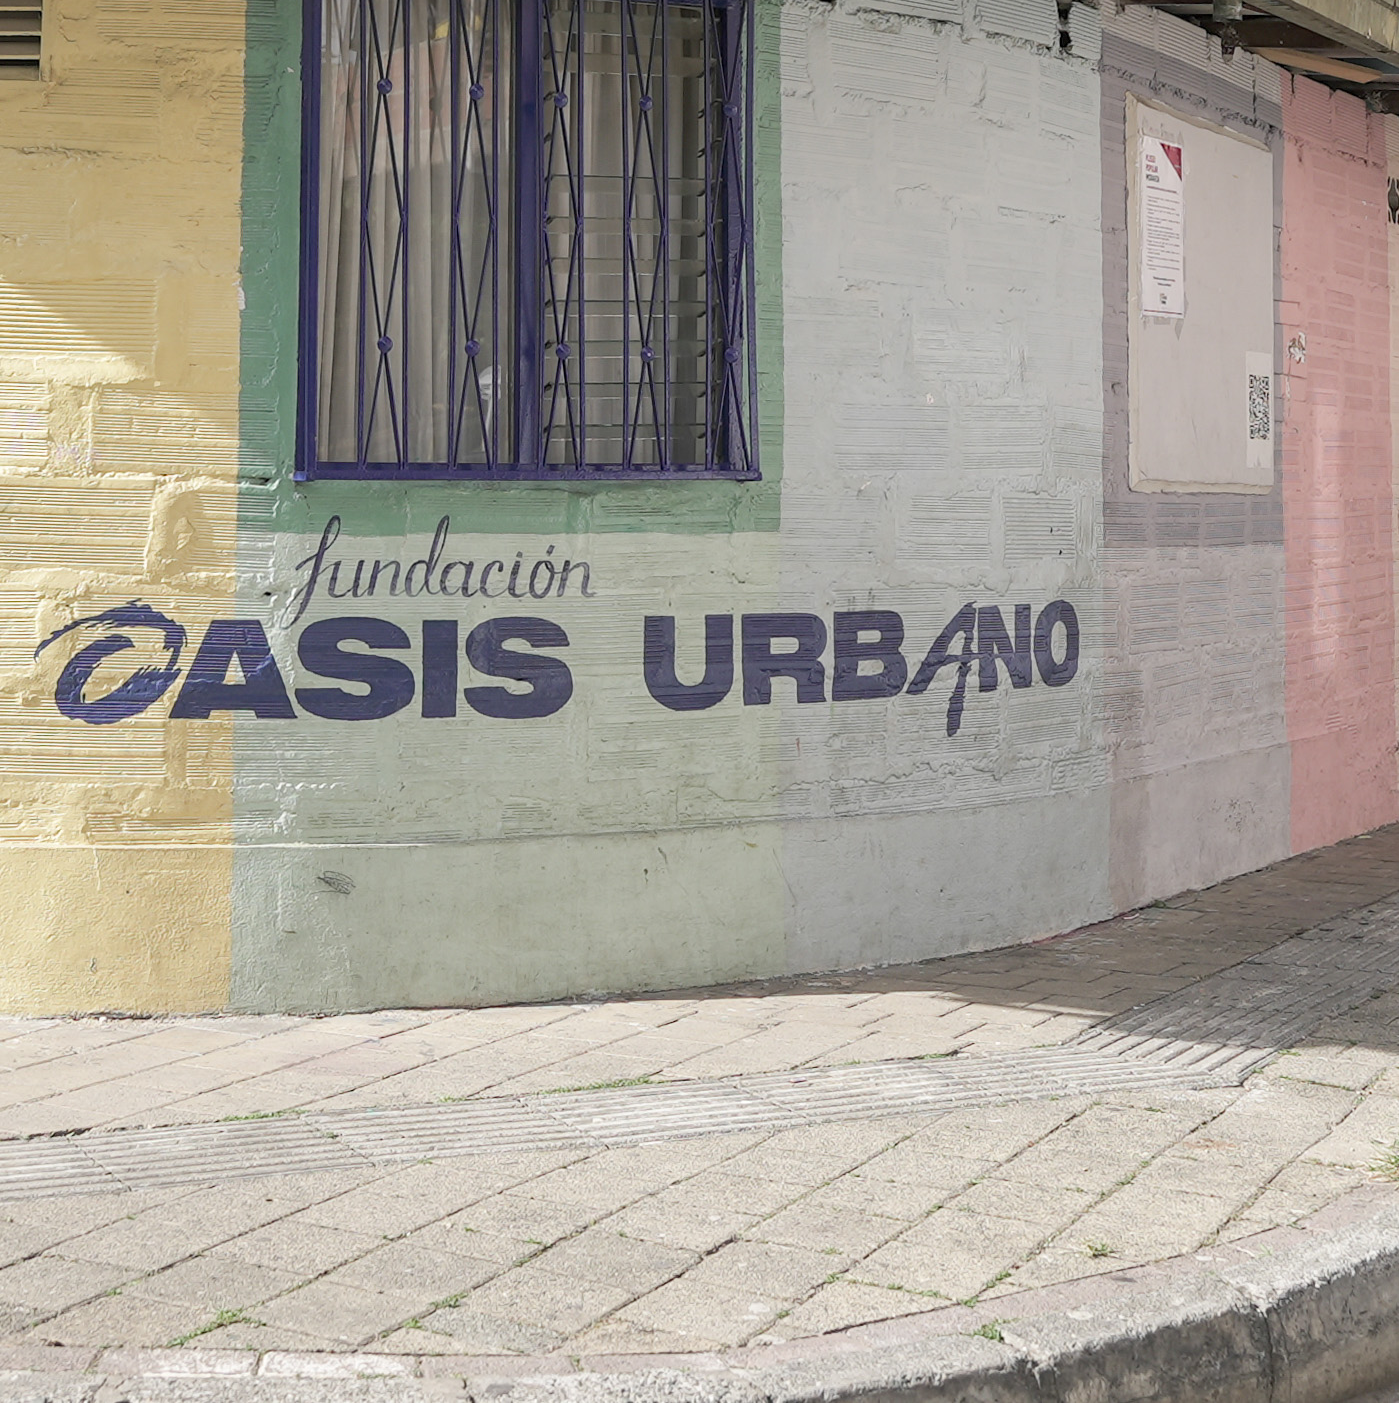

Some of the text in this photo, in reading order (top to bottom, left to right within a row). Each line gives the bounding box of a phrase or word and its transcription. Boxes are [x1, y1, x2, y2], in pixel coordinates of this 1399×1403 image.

[289, 514, 595, 622] fundación
[35, 598, 1080, 736] OASIS URBANO
